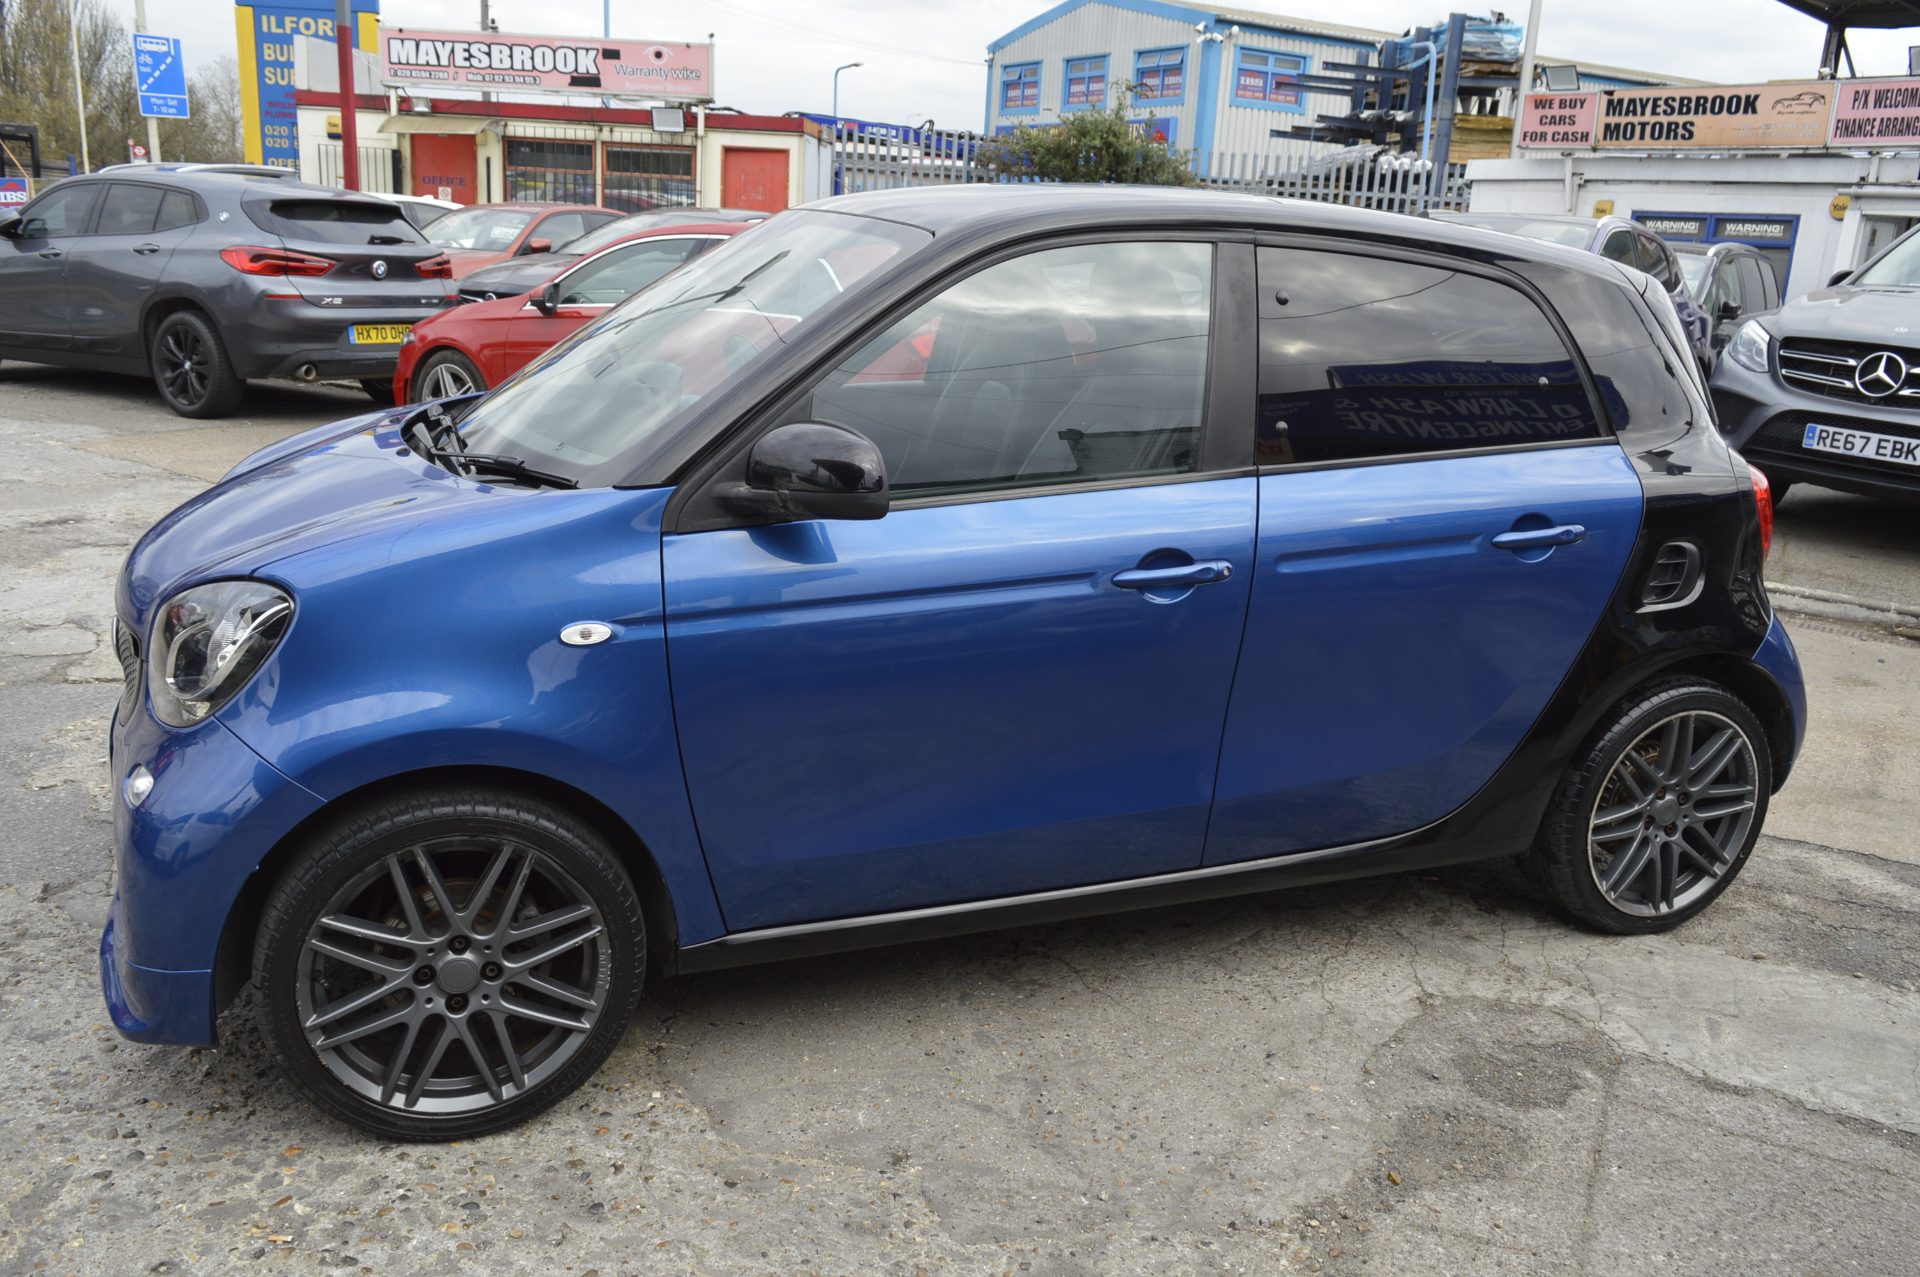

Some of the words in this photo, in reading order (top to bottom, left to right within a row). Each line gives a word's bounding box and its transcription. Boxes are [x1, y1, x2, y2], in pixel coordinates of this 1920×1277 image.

[261, 15, 338, 37] ILFOR
[388, 38, 600, 75] MAYESBROOK
[614, 63, 670, 80] Warranty
[671, 67, 701, 80] wise
[1240, 76, 1264, 87] IBS
[1534, 98, 1556, 110] WE
[1558, 98, 1587, 109] BUY
[1852, 89, 1870, 110] P/X
[1873, 87, 1920, 109] WELCOM
[1605, 94, 1760, 117] MAYESBROOK
[1539, 115, 1576, 126] CARS
[265, 125, 288, 135] 020
[1603, 121, 1695, 142] MOTORS
[1834, 117, 1877, 139] FINANCE
[1876, 116, 1920, 137] ARRANG
[265, 138, 289, 148] 020
[1522, 131, 1547, 142] FOR
[1551, 131, 1590, 142] CASH
[422, 175, 466, 187] OFFICE
[1646, 220, 1699, 231] WARNING!
[1726, 223, 1784, 234] WARNING!
[356, 326, 387, 341] HX70
[1816, 429, 1871, 453] RE67
[1875, 438, 1920, 462] EBK
